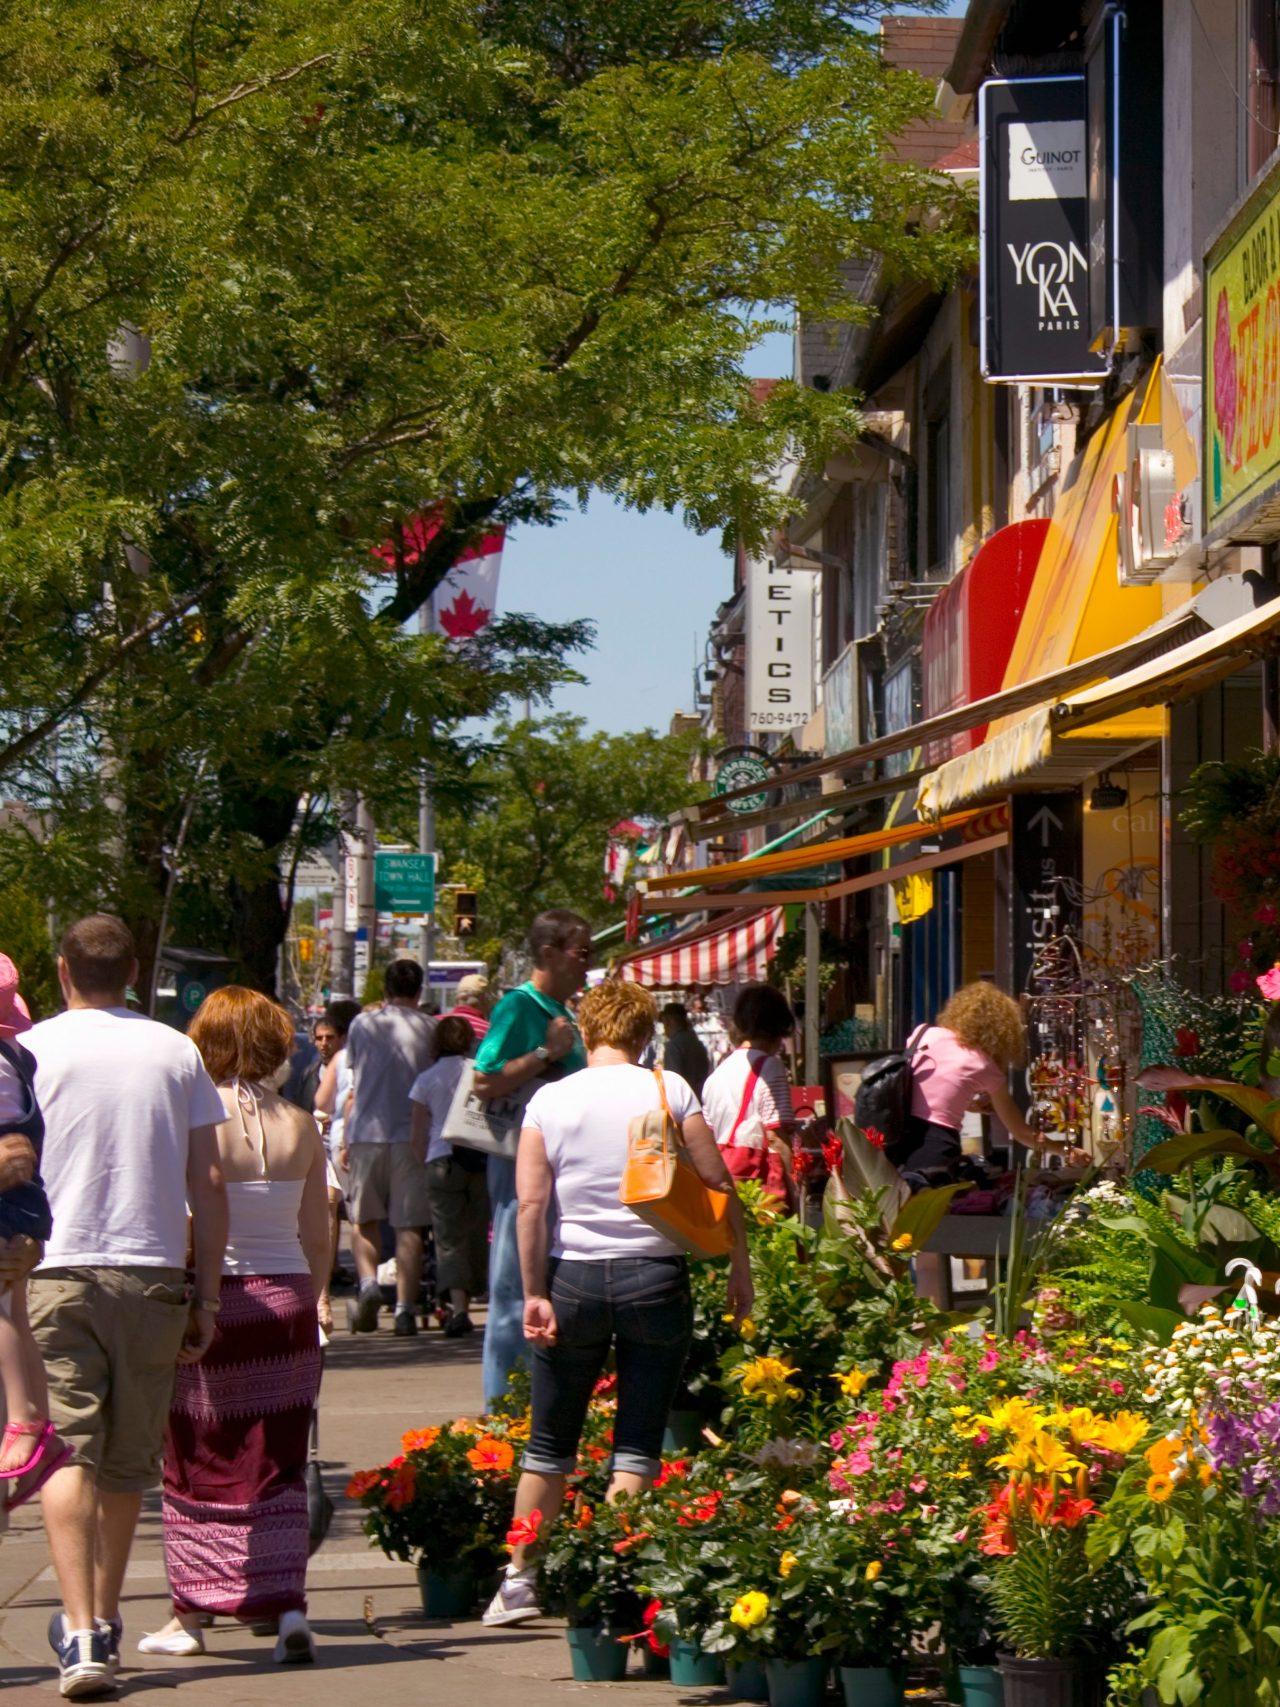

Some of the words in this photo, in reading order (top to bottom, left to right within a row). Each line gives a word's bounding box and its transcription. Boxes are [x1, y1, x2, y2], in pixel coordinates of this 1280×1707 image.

[1242, 234, 1268, 304] BLOOR
[1038, 263, 1079, 318] KA
[1038, 320, 1080, 331] PARIS
[750, 712, 809, 725] 760-9472
[718, 759, 767, 786] STARBUCK
[383, 858, 426, 869] SWANSEA
[379, 871, 403, 882] TOWN
[407, 871, 432, 882] HALL
